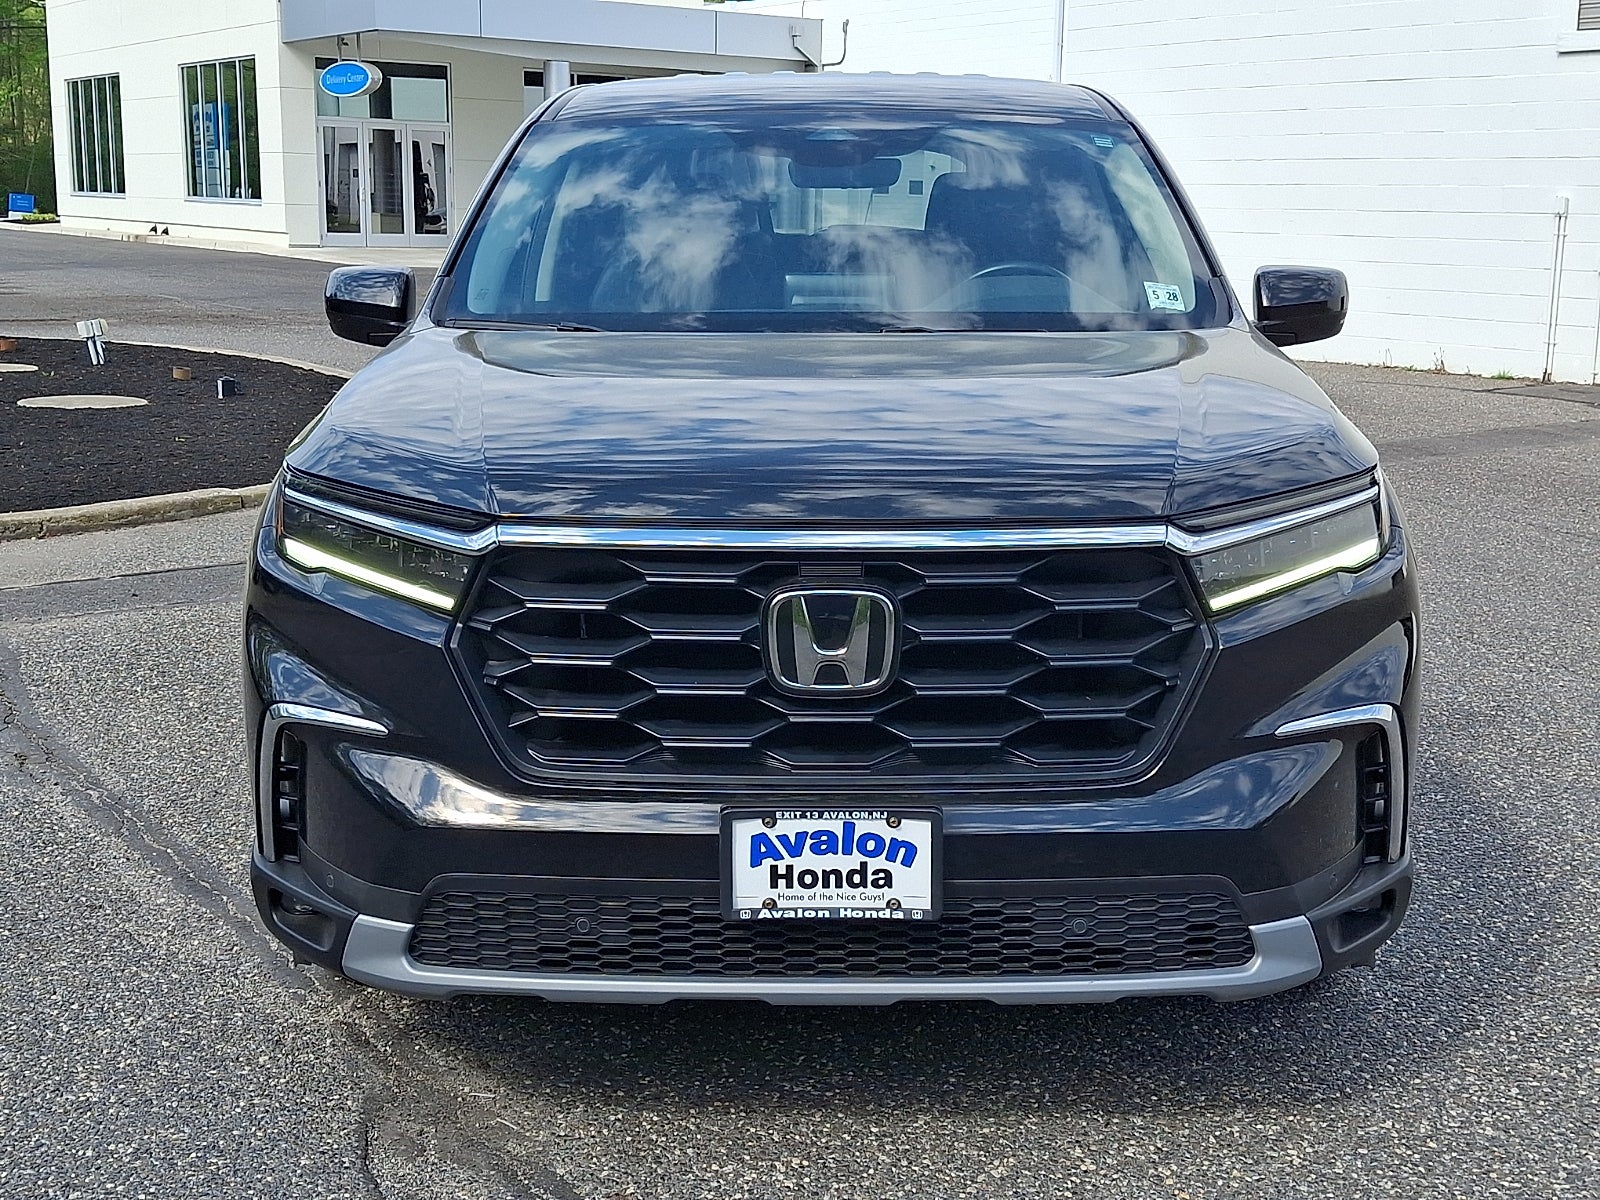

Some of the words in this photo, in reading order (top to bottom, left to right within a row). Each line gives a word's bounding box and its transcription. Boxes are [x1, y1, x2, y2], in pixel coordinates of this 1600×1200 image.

[326, 74, 346, 85] Delivery
[347, 73, 365, 83] Center
[1152, 290, 1160, 299] 5
[1165, 291, 1178, 301] 28
[776, 811, 803, 819] EXIT
[805, 811, 819, 819] 13
[750, 821, 918, 868] Avalon
[769, 861, 893, 889] Honda
[777, 892, 804, 901] Home
[807, 892, 817, 901] of
[819, 892, 834, 901] the
[836, 892, 857, 901] Nice
[859, 892, 885, 903] Guys!
[757, 908, 831, 919] Avalon
[839, 908, 904, 919] Honda
